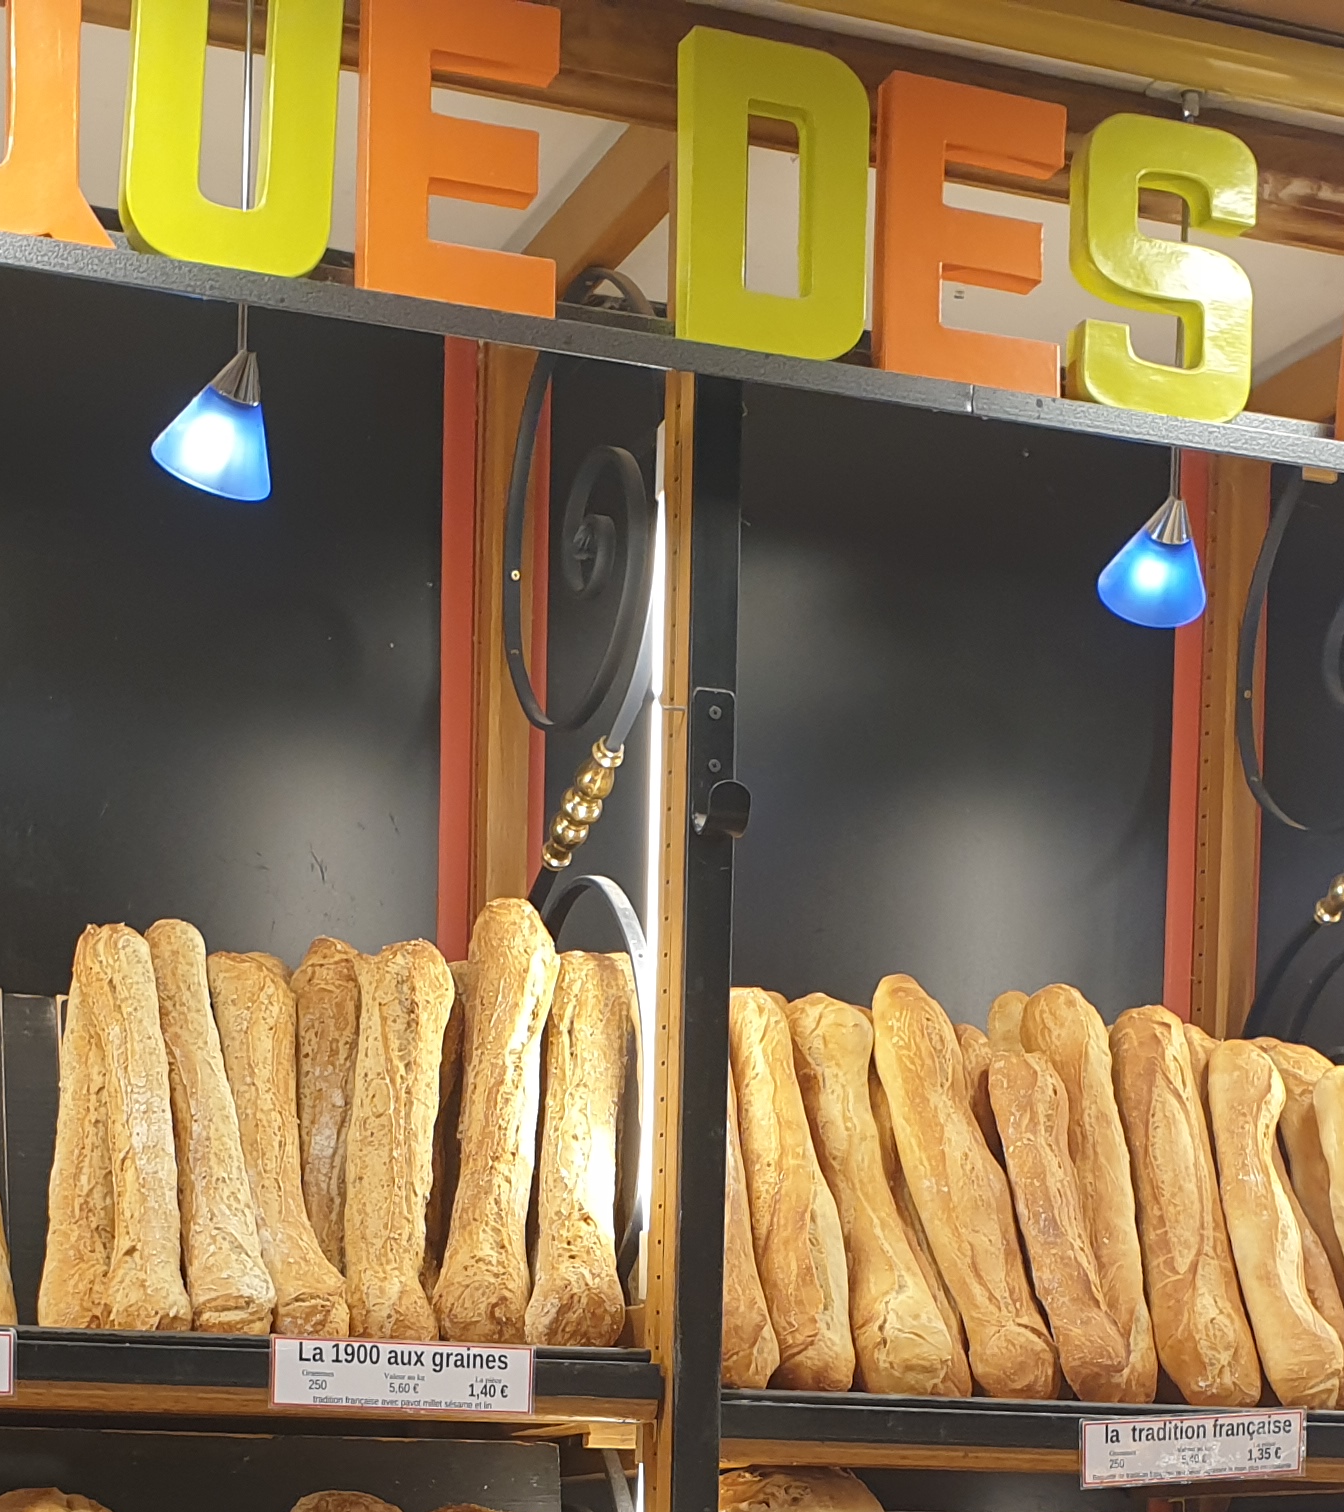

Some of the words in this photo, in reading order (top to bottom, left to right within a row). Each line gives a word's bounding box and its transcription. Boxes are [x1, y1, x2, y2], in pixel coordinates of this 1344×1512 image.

[675, 25, 1260, 424] DES
[299, 1341, 325, 1363] La
[331, 1343, 380, 1365] 1900
[387, 1349, 425, 1367] aux
[432, 1347, 508, 1372] graines
[308, 1379, 327, 1390] 250
[469, 1383, 496, 1399] 1,40
[500, 1385, 509, 1398] €
[1105, 1425, 1120, 1444] la
[1131, 1422, 1207, 1442] tradition
[1213, 1416, 1292, 1441] française
[1248, 1447, 1271, 1462] 1,35
[1275, 1447, 1281, 1459] €
[1109, 1459, 1124, 1469] 250
